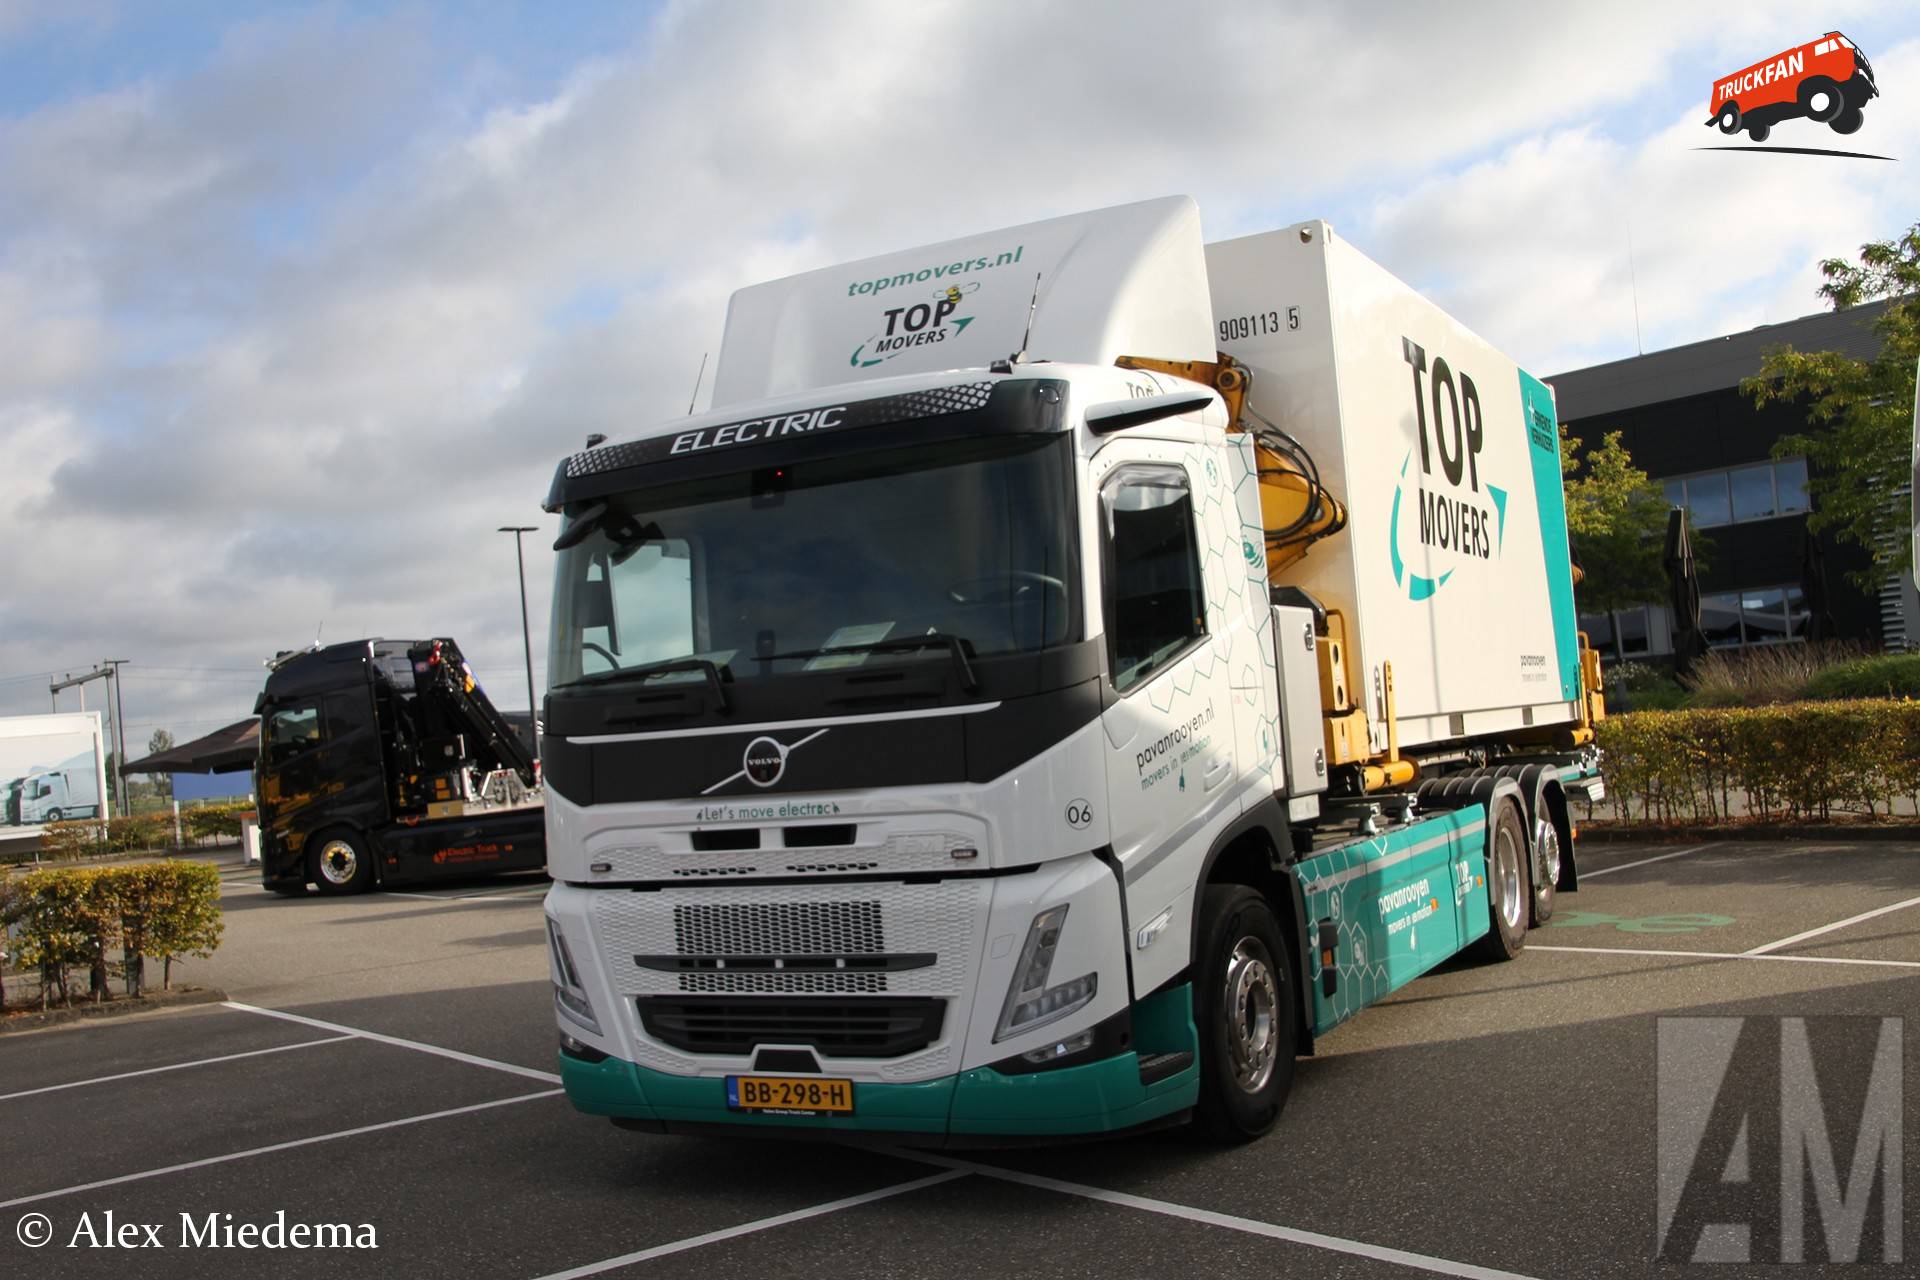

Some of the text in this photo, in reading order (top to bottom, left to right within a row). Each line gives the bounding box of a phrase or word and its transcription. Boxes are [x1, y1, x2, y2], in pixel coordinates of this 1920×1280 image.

[847, 245, 1024, 297] topmovers.nl
[883, 298, 956, 337] TOP
[1219, 307, 1300, 342] 909113 5
[875, 328, 948, 354] MOVERS
[669, 406, 848, 455] ELECTRIC
[1401, 334, 1484, 494] TOP
[1419, 487, 1490, 561] MOVERS
[1136, 696, 1215, 776] pavanrooyen.nl
[748, 757, 782, 766] VOLVO
[705, 804, 734, 821] Let's
[738, 806, 774, 818] move
[1067, 804, 1091, 824] 06
[743, 1081, 845, 1106] BB-298-H
